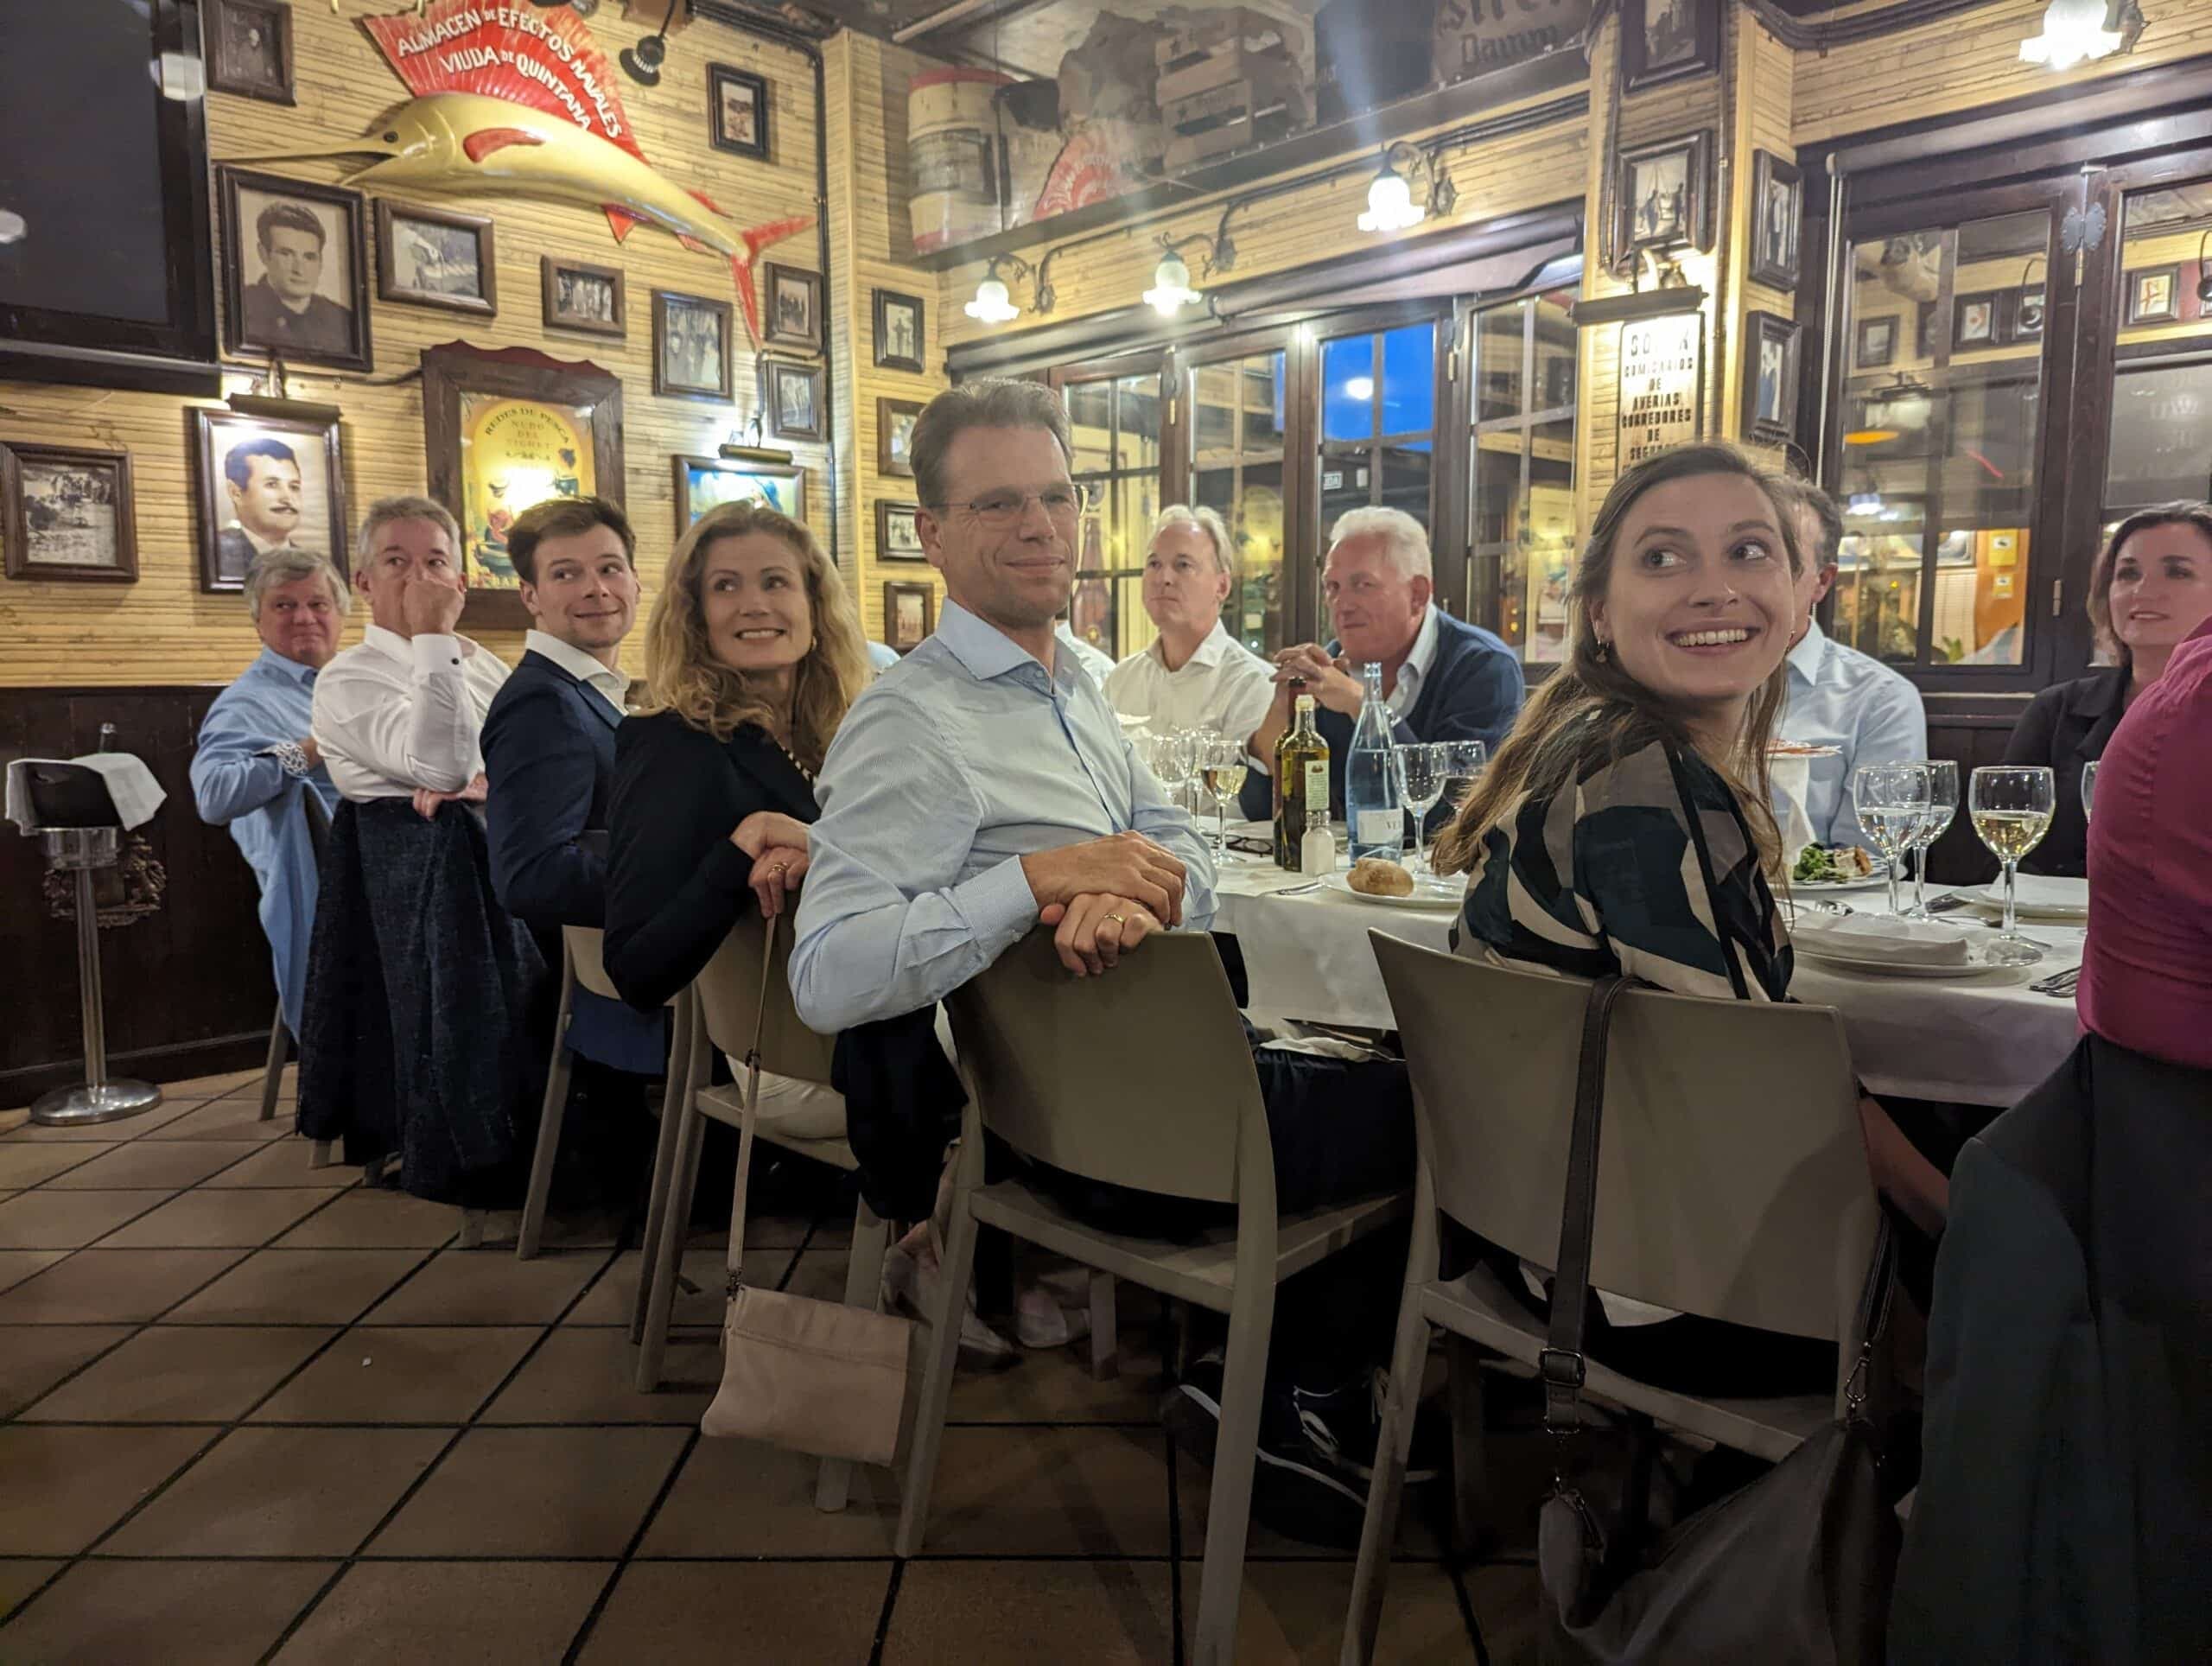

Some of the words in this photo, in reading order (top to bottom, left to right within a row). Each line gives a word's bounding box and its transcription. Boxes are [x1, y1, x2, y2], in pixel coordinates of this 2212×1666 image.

[397, 11, 481, 58] ALMACEN
[485, 10, 497, 22] DE
[498, 7, 574, 63] EFECTOS
[570, 60, 622, 139] NAVALES
[440, 46, 500, 74] VIUDA
[501, 49, 515, 63] DE
[516, 54, 591, 130] QUINTANA
